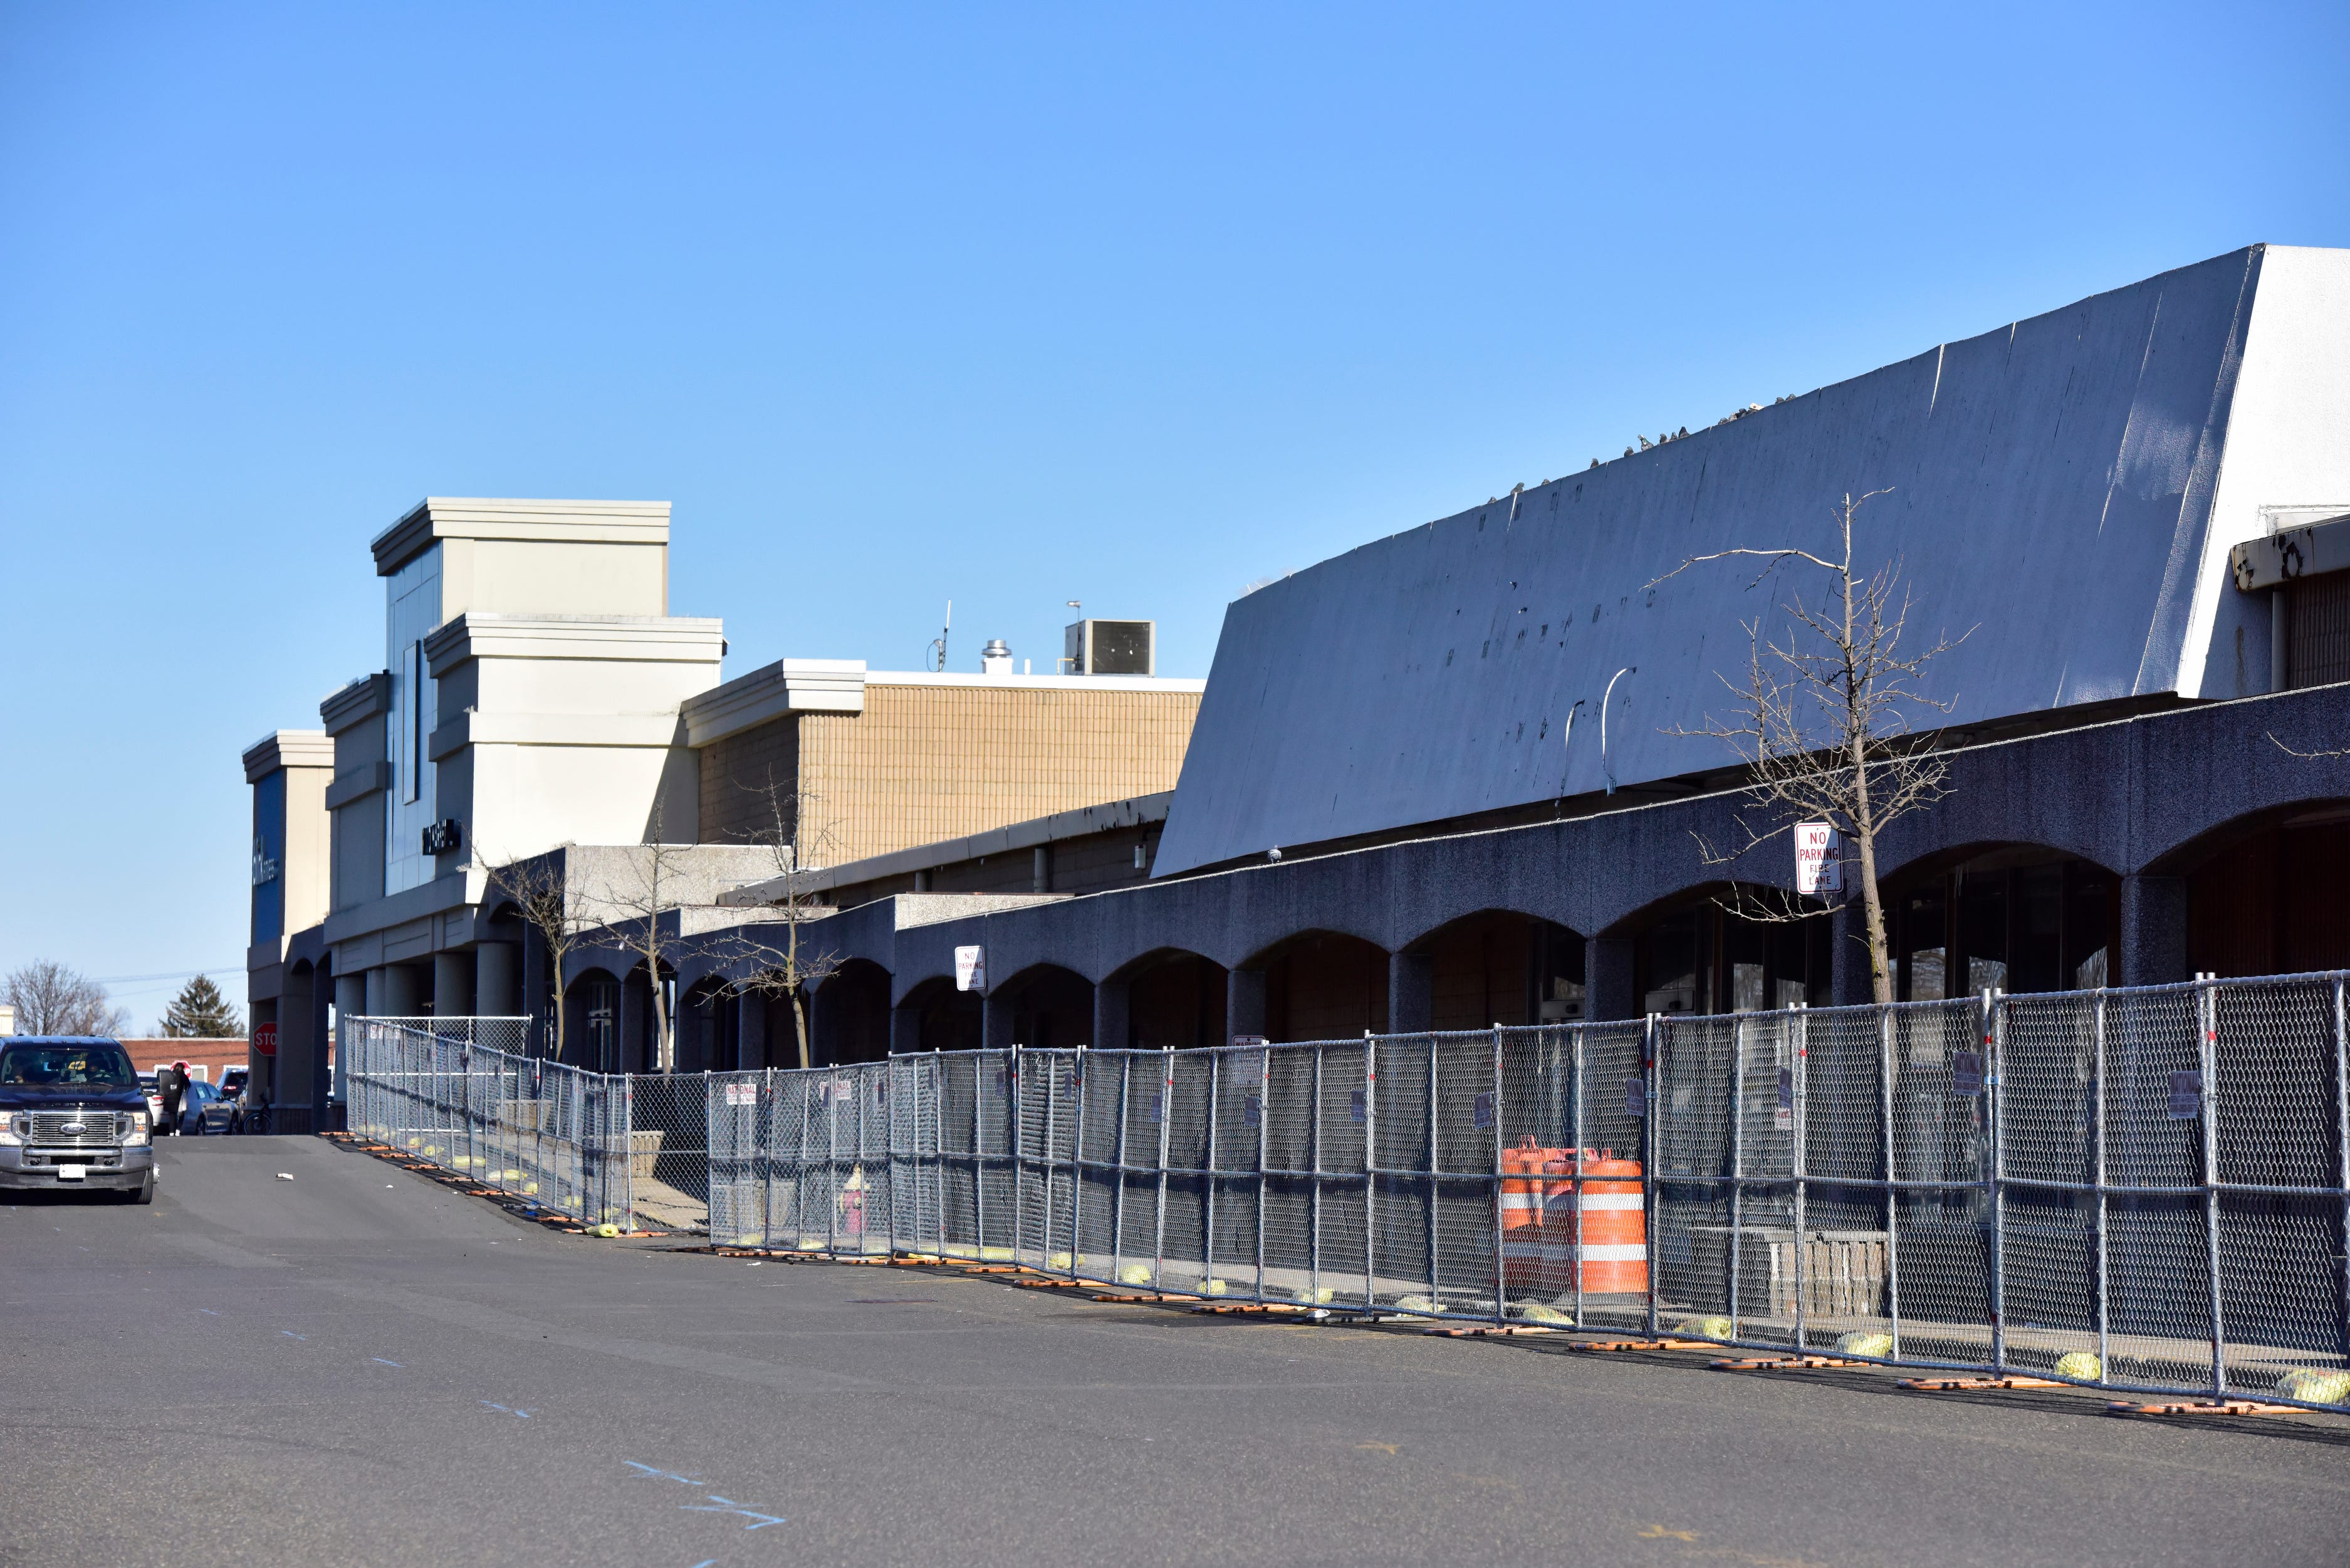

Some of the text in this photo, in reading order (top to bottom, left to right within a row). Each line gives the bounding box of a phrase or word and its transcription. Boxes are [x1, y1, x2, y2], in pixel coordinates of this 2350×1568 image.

[1810, 832, 1826, 845] NO
[1800, 847, 1839, 861] PARKING
[1810, 864, 1829, 873] FIRE
[1809, 875, 1832, 885] LANE
[965, 952, 975, 960] NO
[958, 961, 983, 970] PARKING
[256, 1033, 276, 1045] STO
[727, 1085, 756, 1095] NATONAL
